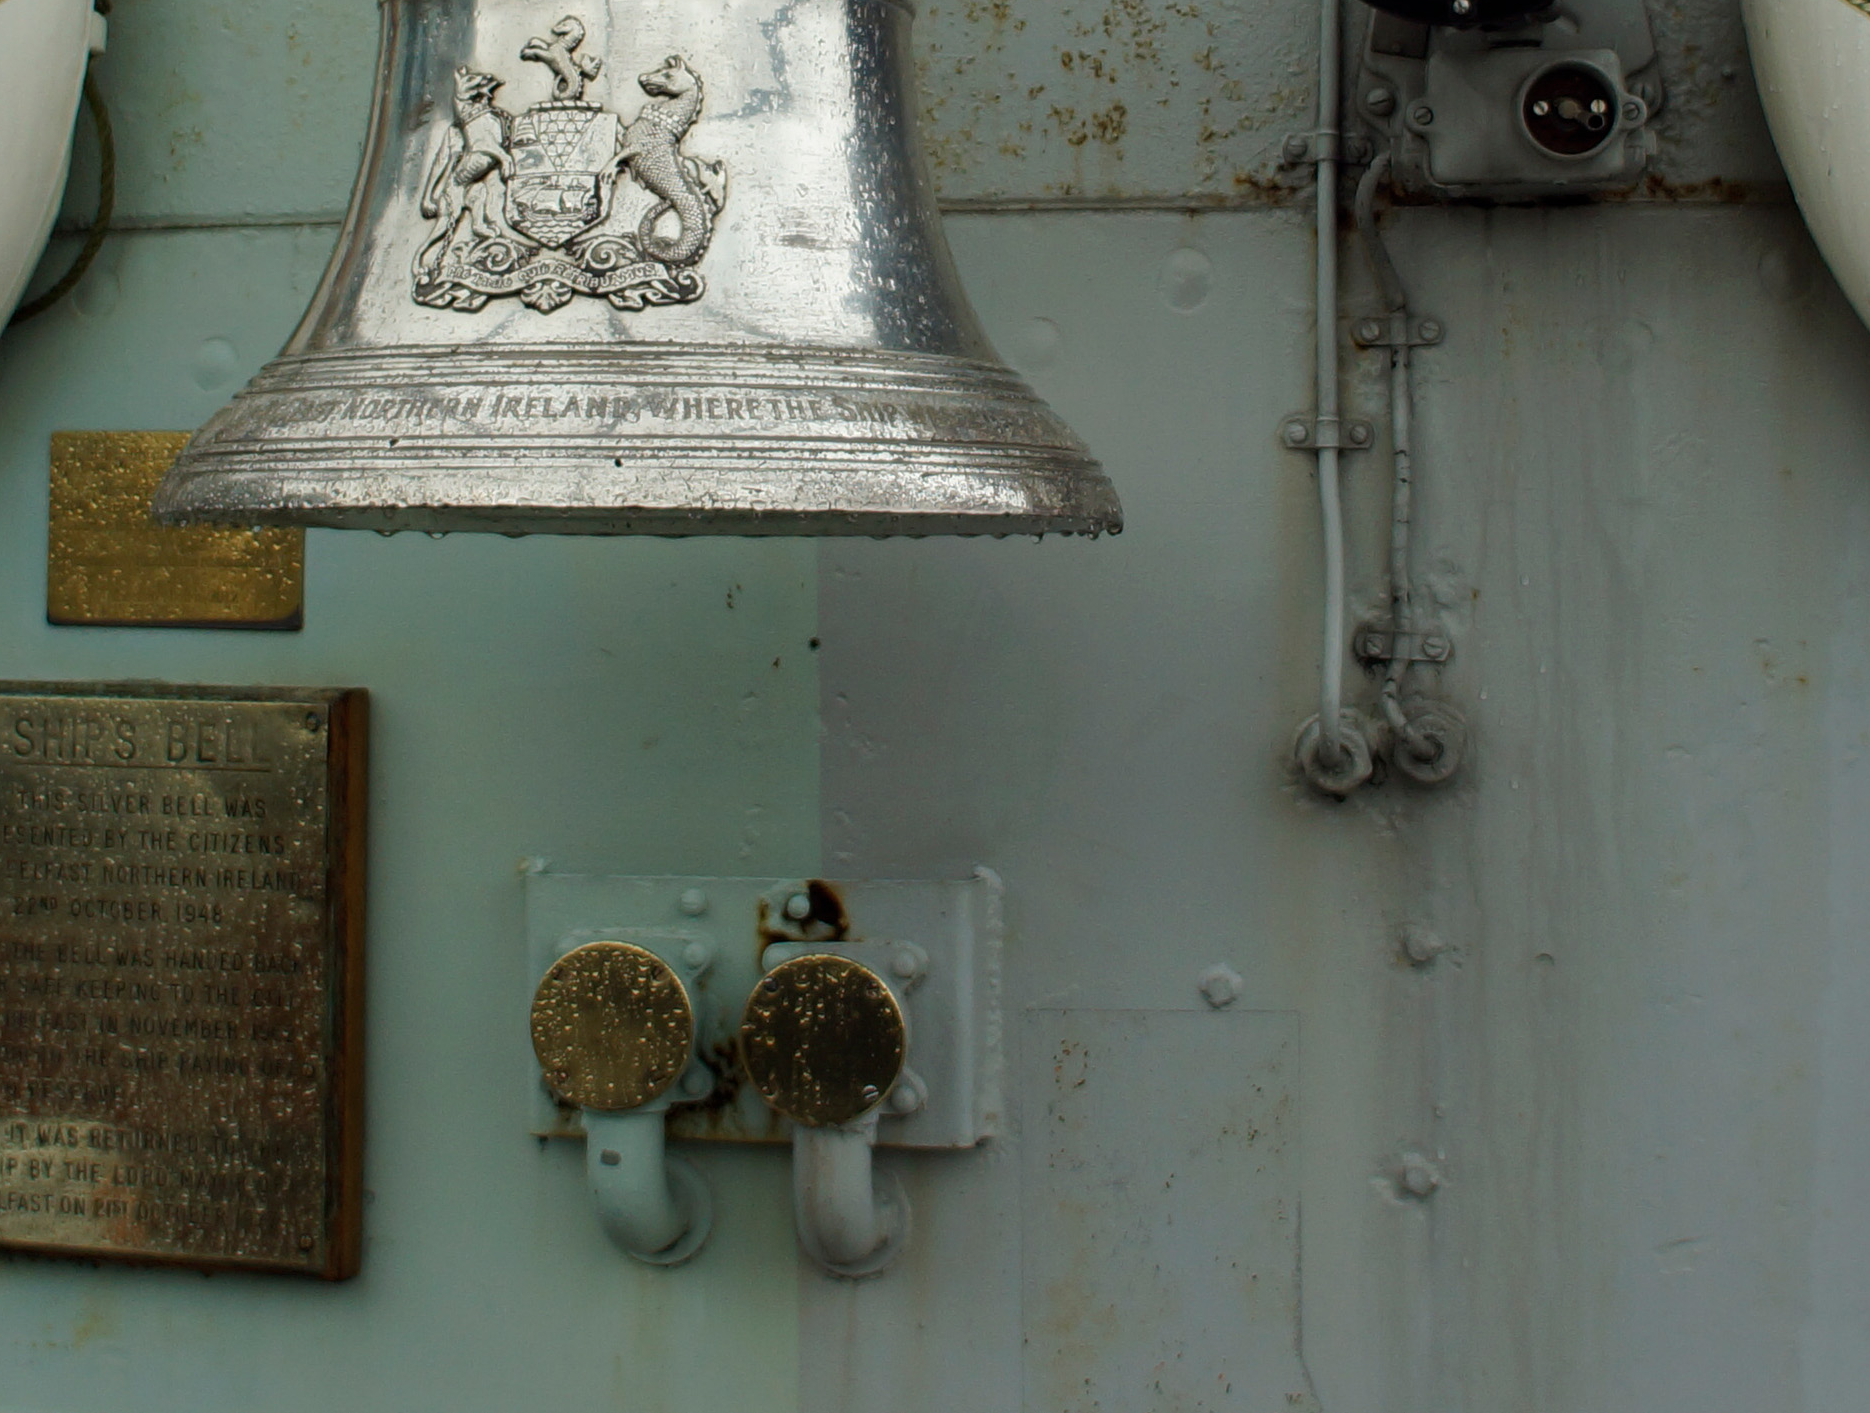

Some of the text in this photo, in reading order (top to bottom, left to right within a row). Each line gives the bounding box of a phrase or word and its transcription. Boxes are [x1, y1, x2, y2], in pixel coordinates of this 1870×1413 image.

[166, 721, 272, 764] BELL
[18, 790, 267, 819] THIS SILVER BELL WAS
[104, 828, 128, 848] BY
[138, 830, 176, 852] THE
[188, 832, 286, 855] CITIZENS
[102, 865, 207, 889] NORTHERN
[216, 869, 300, 891] IRELAND
[176, 900, 223, 924] 1948
[11, 941, 46, 962] THE
[116, 946, 154, 968] WAS
[168, 983, 194, 1005] TO
[129, 1016, 238, 1039] NOVEMBER
[35, 1124, 79, 1147] WAS
[29, 1157, 54, 1180] BY
[62, 1160, 101, 1183] THE
[59, 1194, 86, 1216] ON
